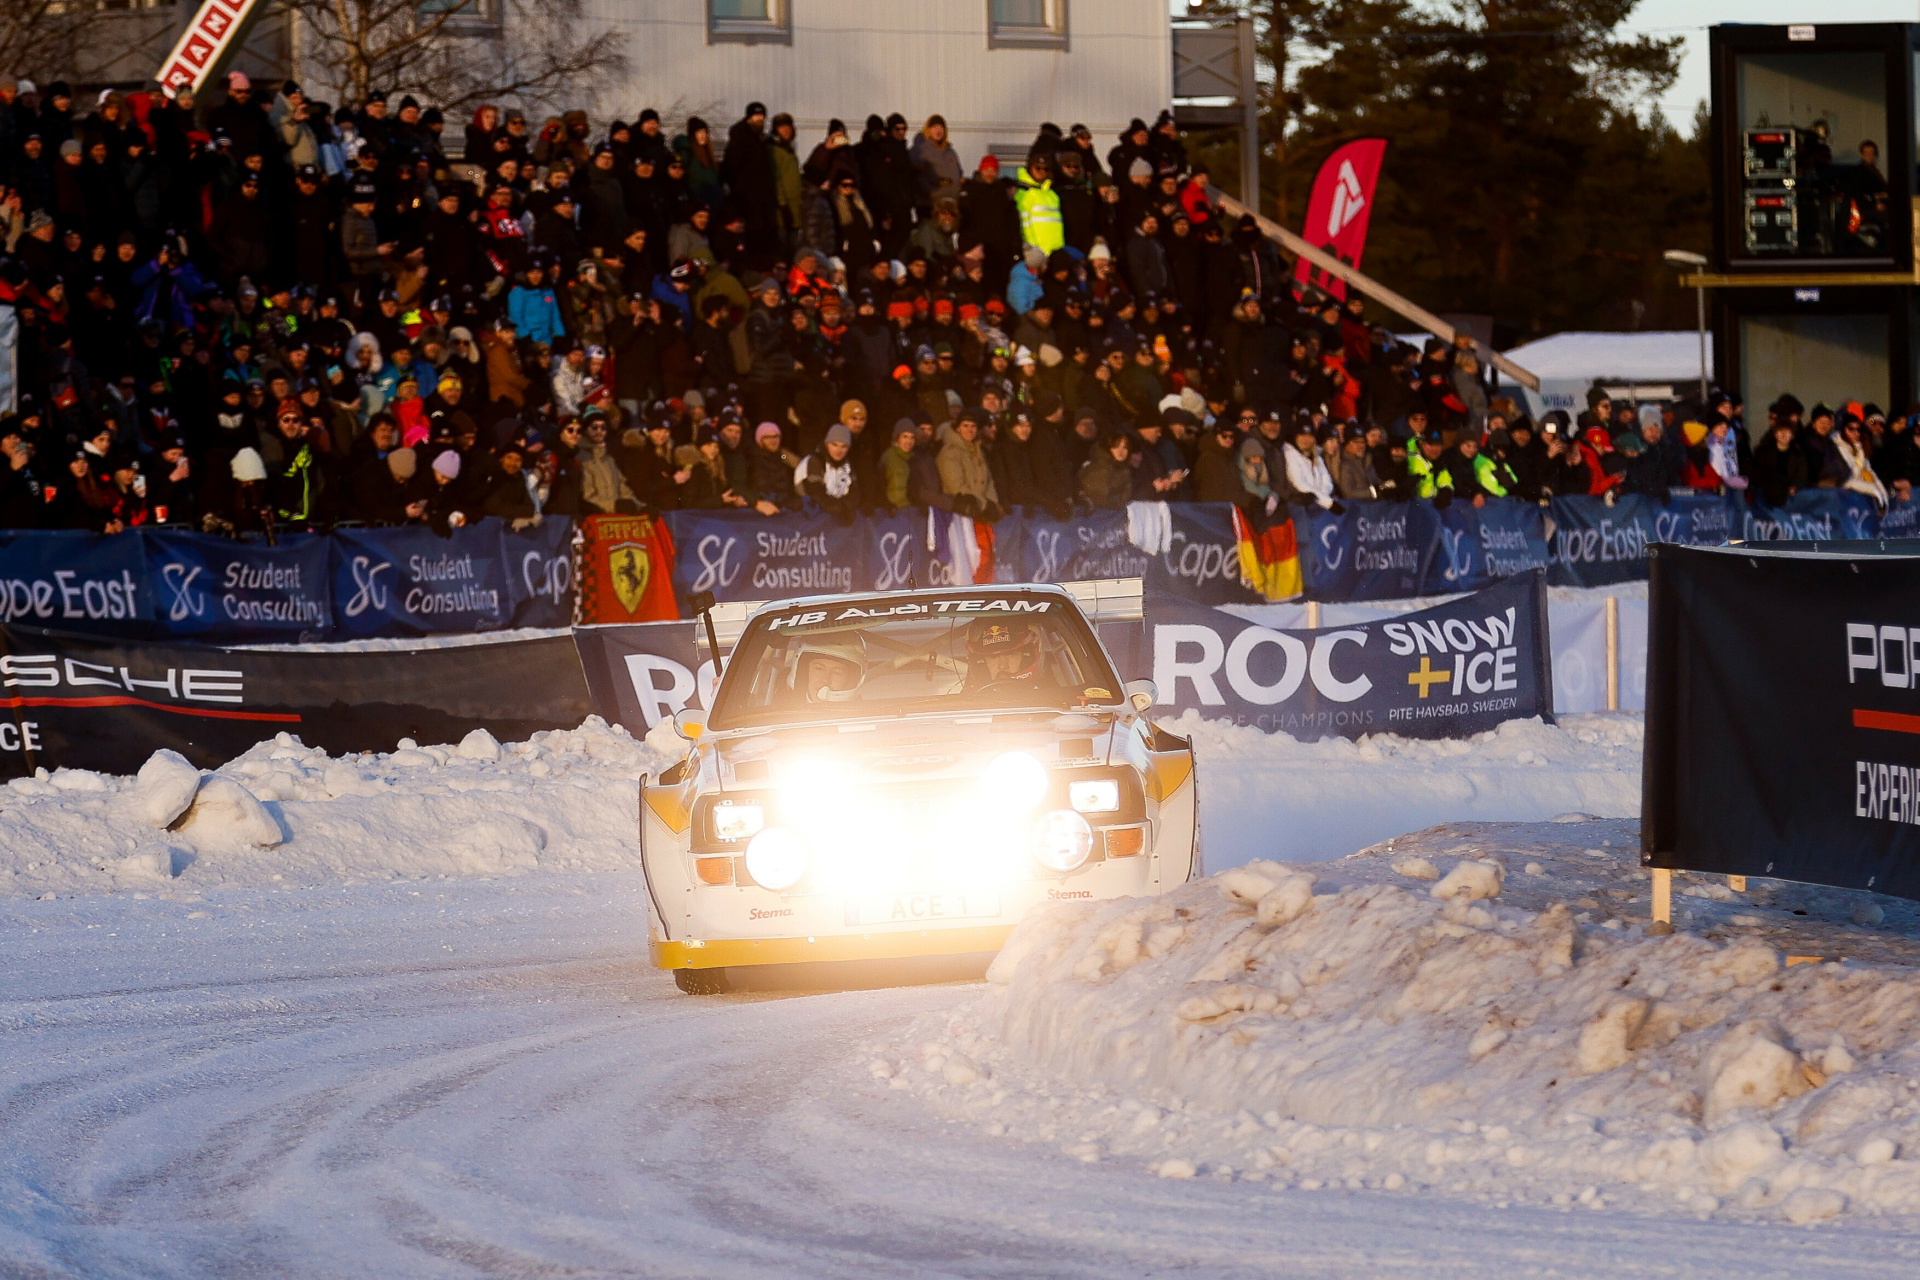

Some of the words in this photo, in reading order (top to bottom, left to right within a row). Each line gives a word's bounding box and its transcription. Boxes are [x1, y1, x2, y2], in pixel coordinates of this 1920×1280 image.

[756, 531, 828, 558] Student
[223, 561, 301, 589] Student
[410, 553, 474, 583] Student
[753, 561, 852, 593] Consulting
[223, 593, 325, 628] Consulting
[405, 583, 500, 616] Consulting
[768, 611, 828, 631] HB
[933, 599, 1052, 613] TEAM
[1383, 606, 1516, 656] SNOW
[0, 655, 244, 703] SCHE
[1151, 624, 1373, 706] ROC
[1257, 709, 1374, 730] CHAMPIONS
[1389, 707, 1412, 721] PITE
[1416, 702, 1470, 719] HAVSBAD,
[1472, 697, 1518, 714] SWEDEN
[891, 895, 945, 919] ACE
[1047, 888, 1094, 900] Stema.
[749, 907, 795, 920] Stema.
